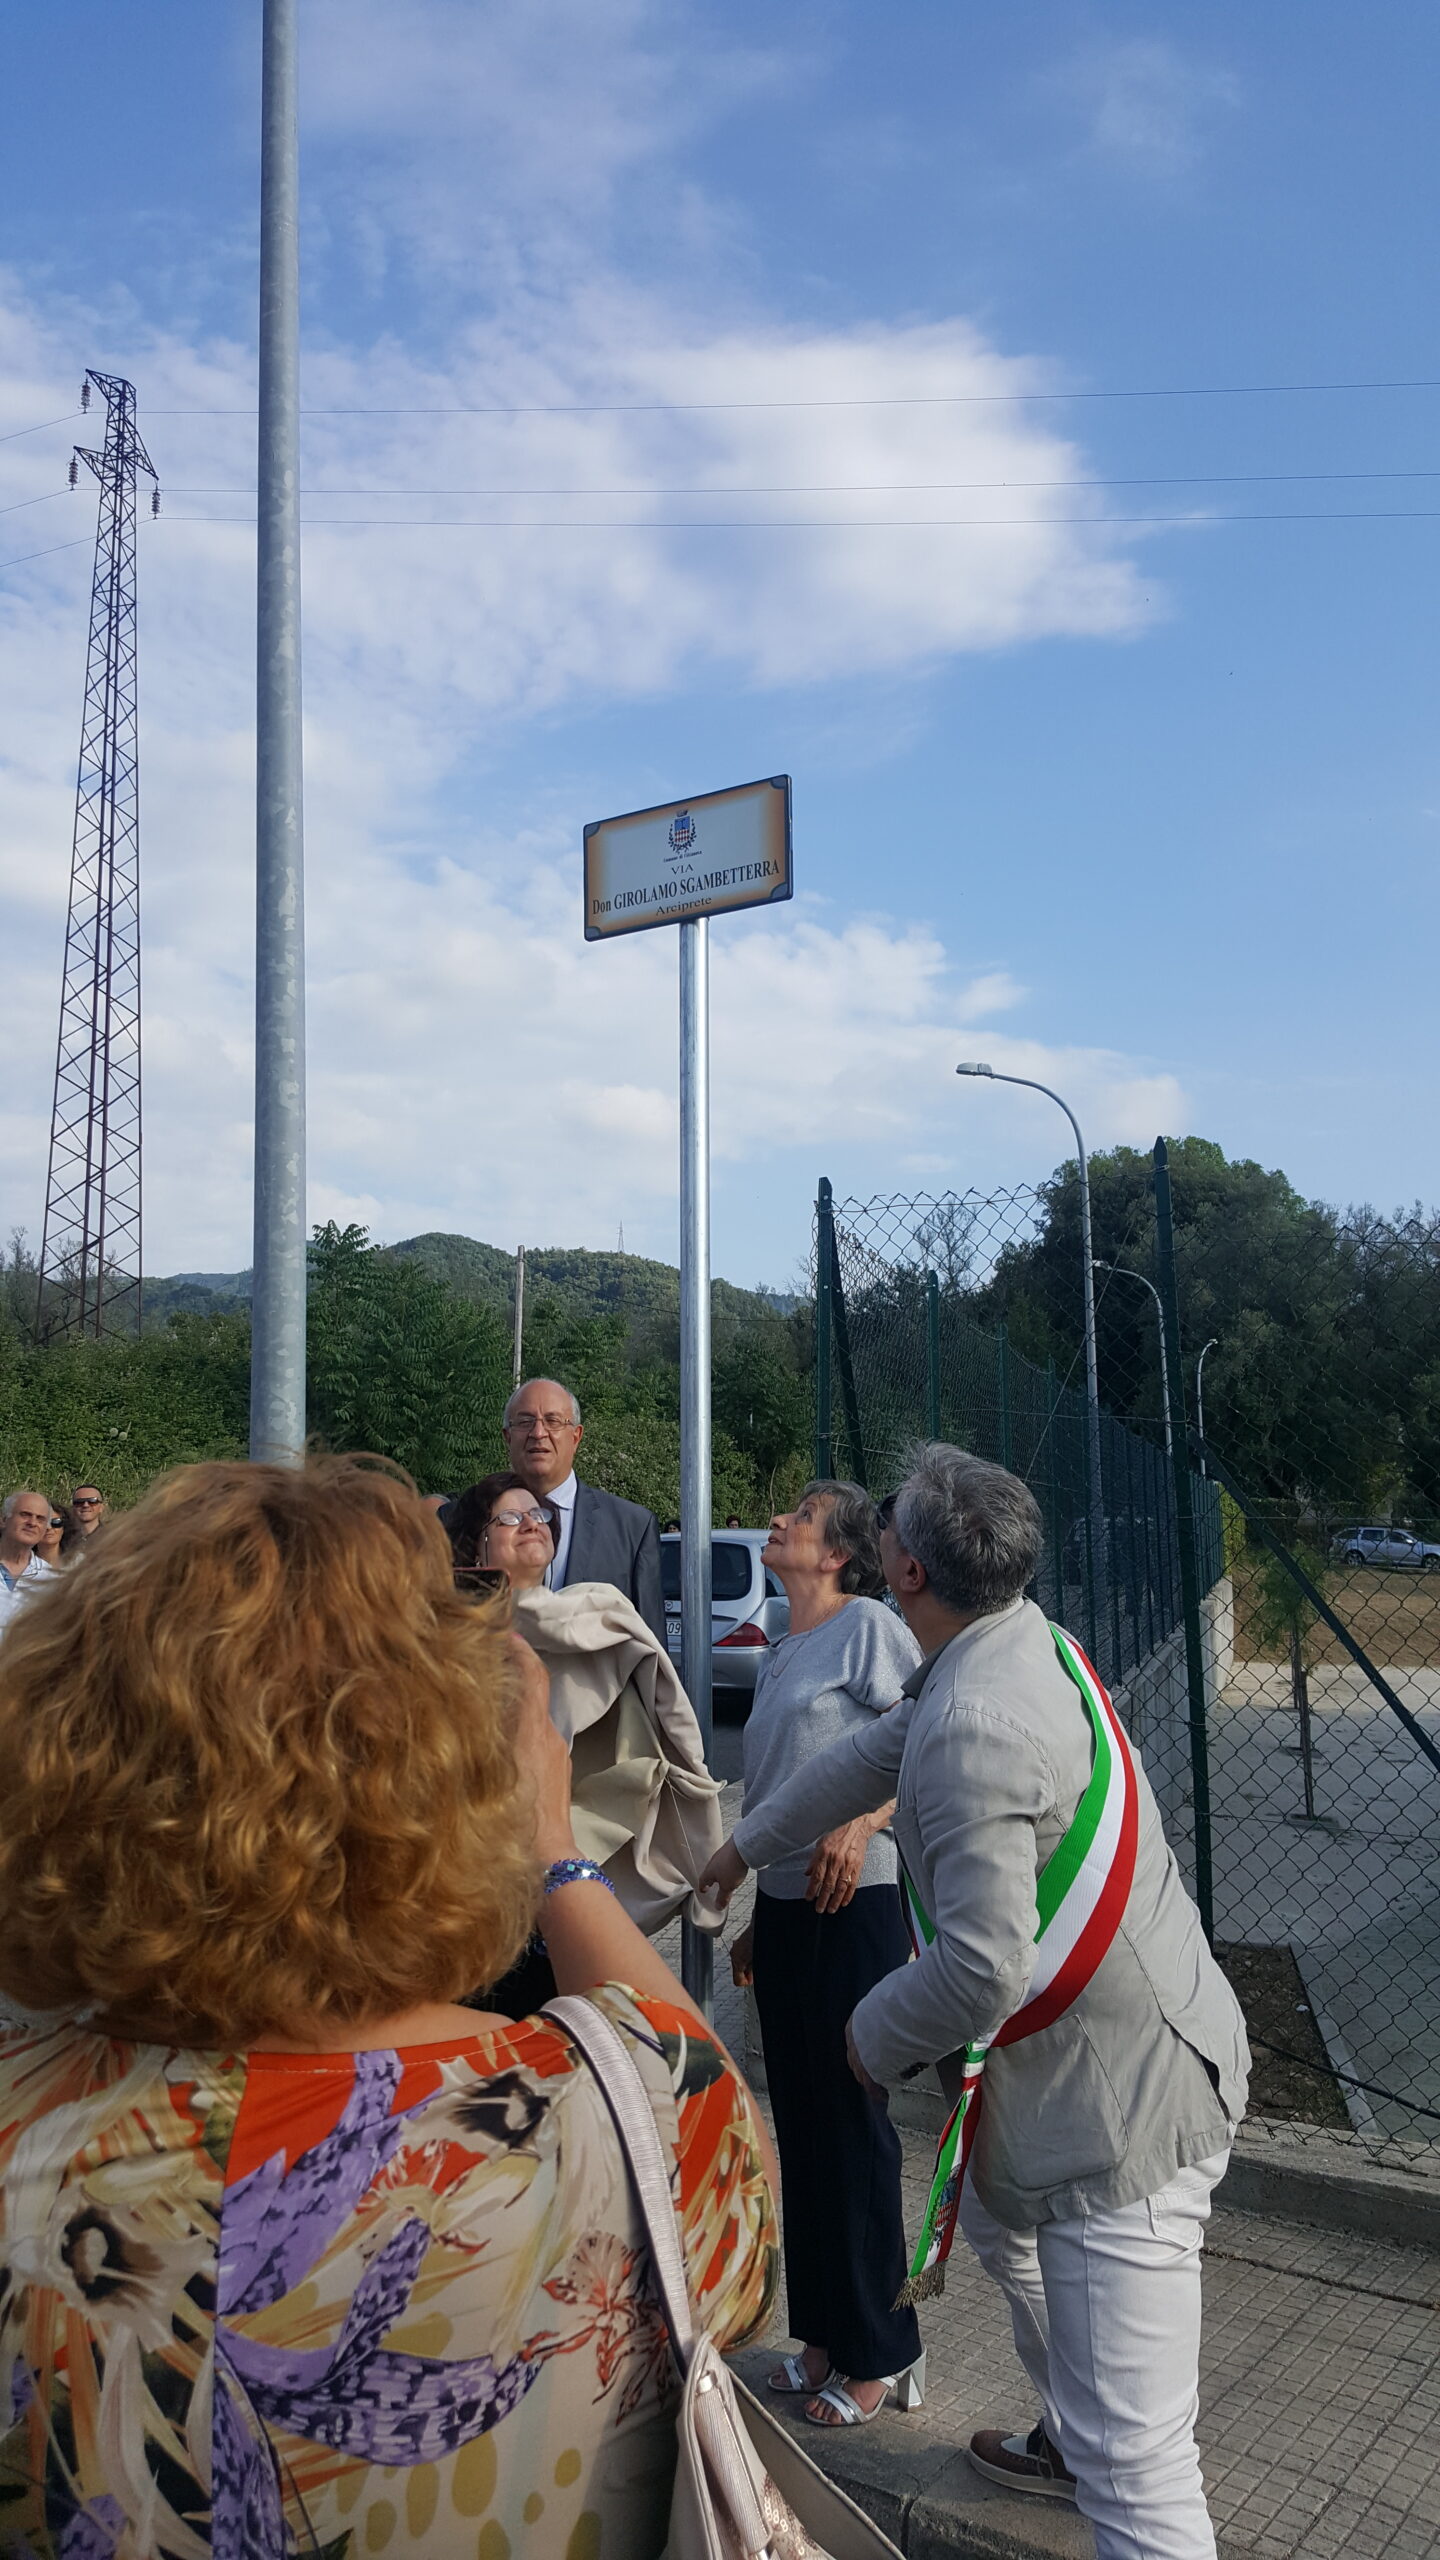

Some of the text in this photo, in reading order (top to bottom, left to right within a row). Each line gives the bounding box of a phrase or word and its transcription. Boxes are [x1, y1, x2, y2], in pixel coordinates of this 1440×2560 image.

[671, 863, 694, 875] VIA
[592, 859, 780, 915] Don GIROLAMO SGAMBETTERRA
[656, 897, 712, 917] Arciprete
